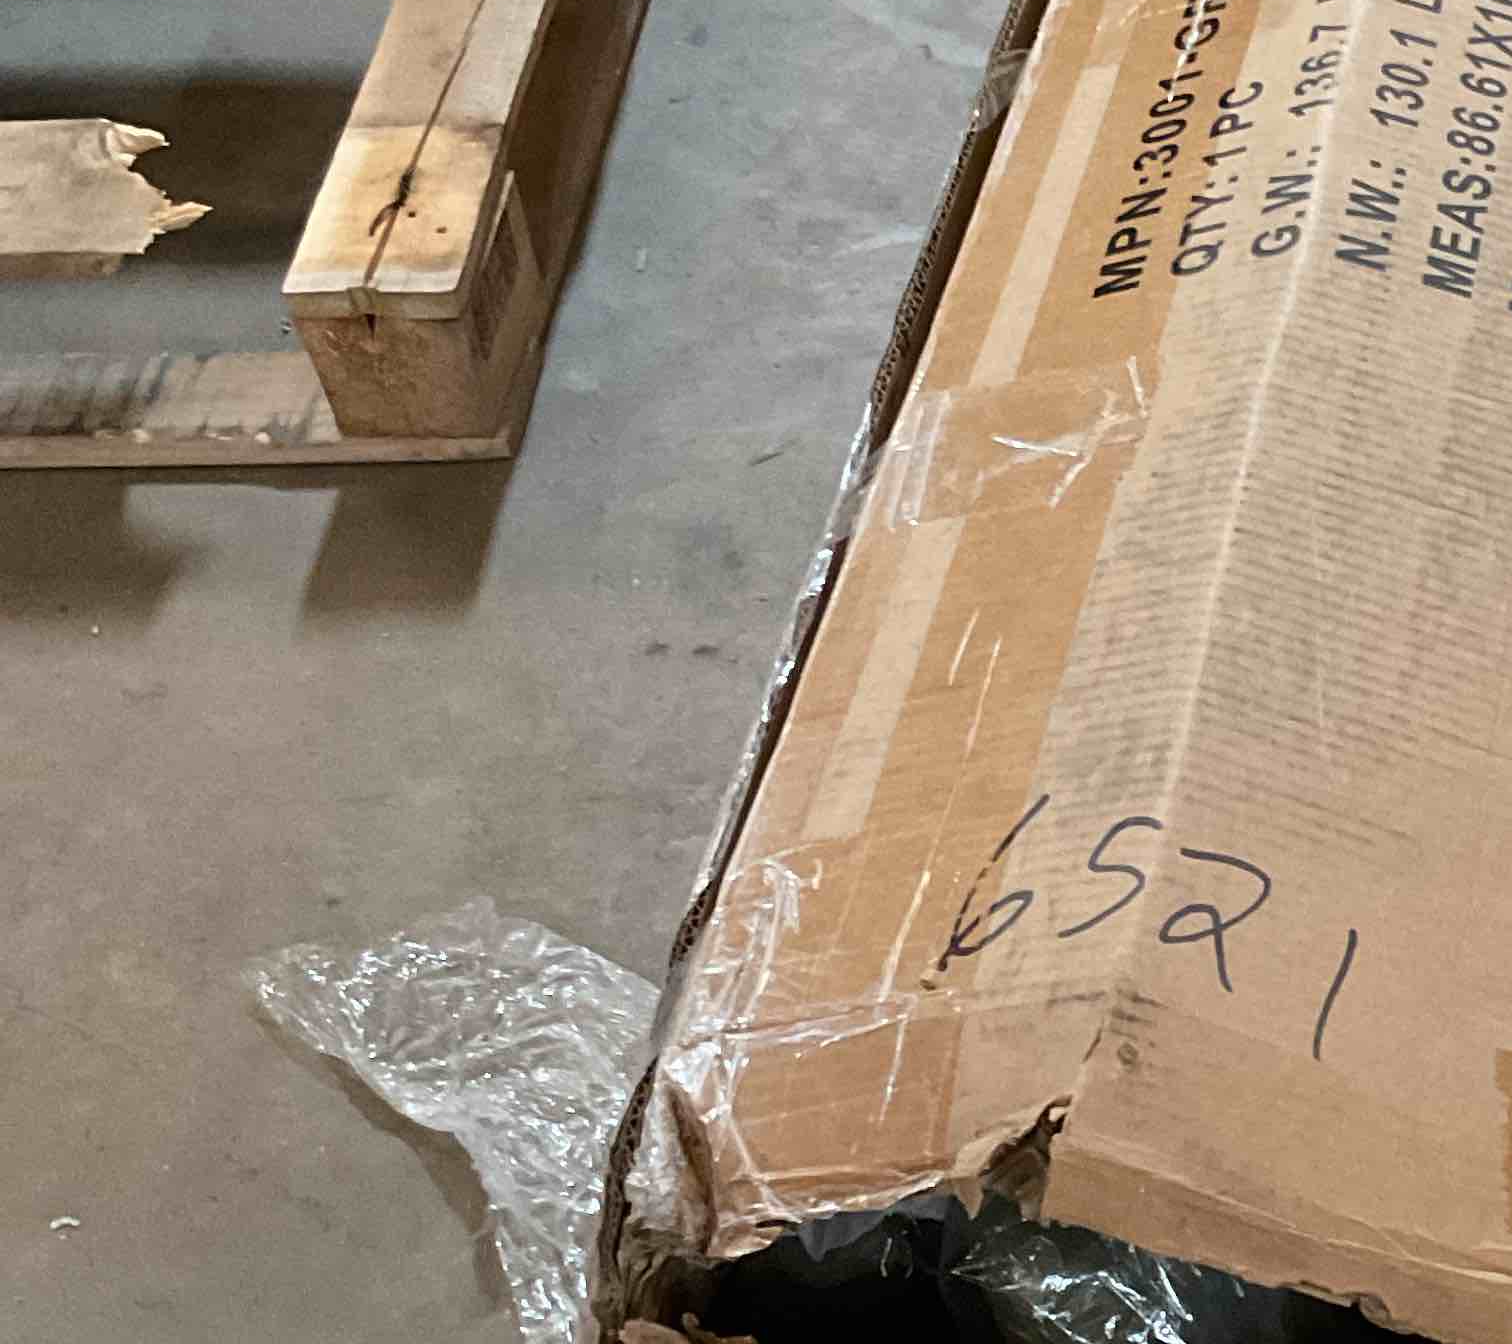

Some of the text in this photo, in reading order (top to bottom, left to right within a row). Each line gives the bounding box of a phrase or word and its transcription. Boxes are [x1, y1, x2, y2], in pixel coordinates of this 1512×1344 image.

[1370, 28, 1437, 128] 130.1
[1251, 145, 1322, 258] G.W.:
[1288, 24, 1347, 117] 136.7
[1335, 159, 1407, 272] N.W.:
